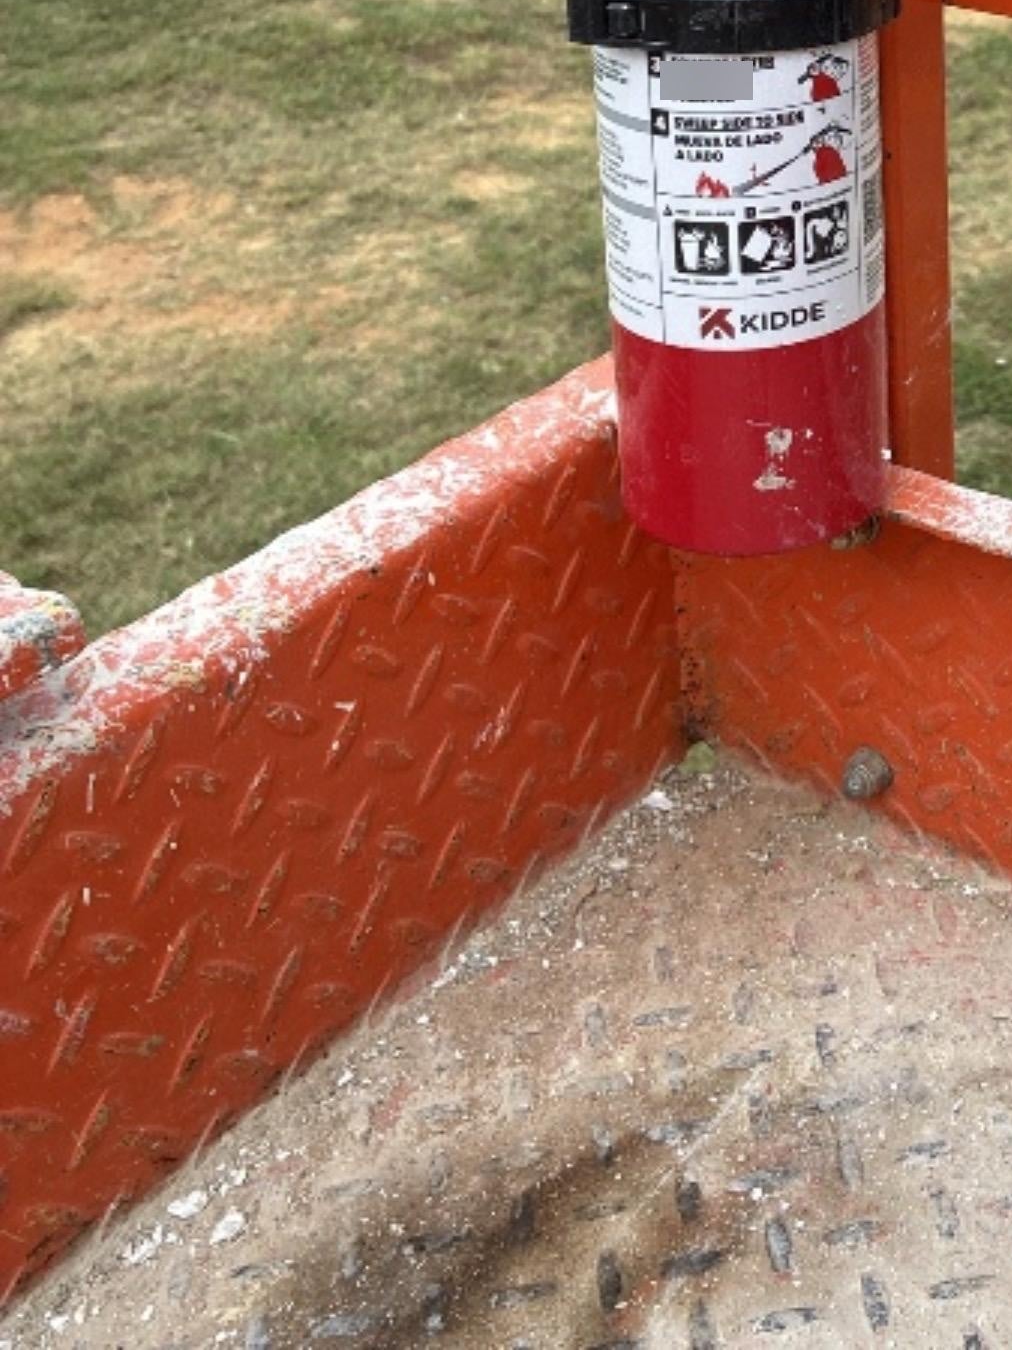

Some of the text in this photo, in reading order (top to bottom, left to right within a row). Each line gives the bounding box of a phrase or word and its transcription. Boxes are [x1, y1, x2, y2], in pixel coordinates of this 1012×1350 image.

[725, 135, 742, 148] DE
[746, 131, 783, 148] LADO
[674, 149, 724, 163] A LADO
[740, 302, 827, 334] KIDDE
